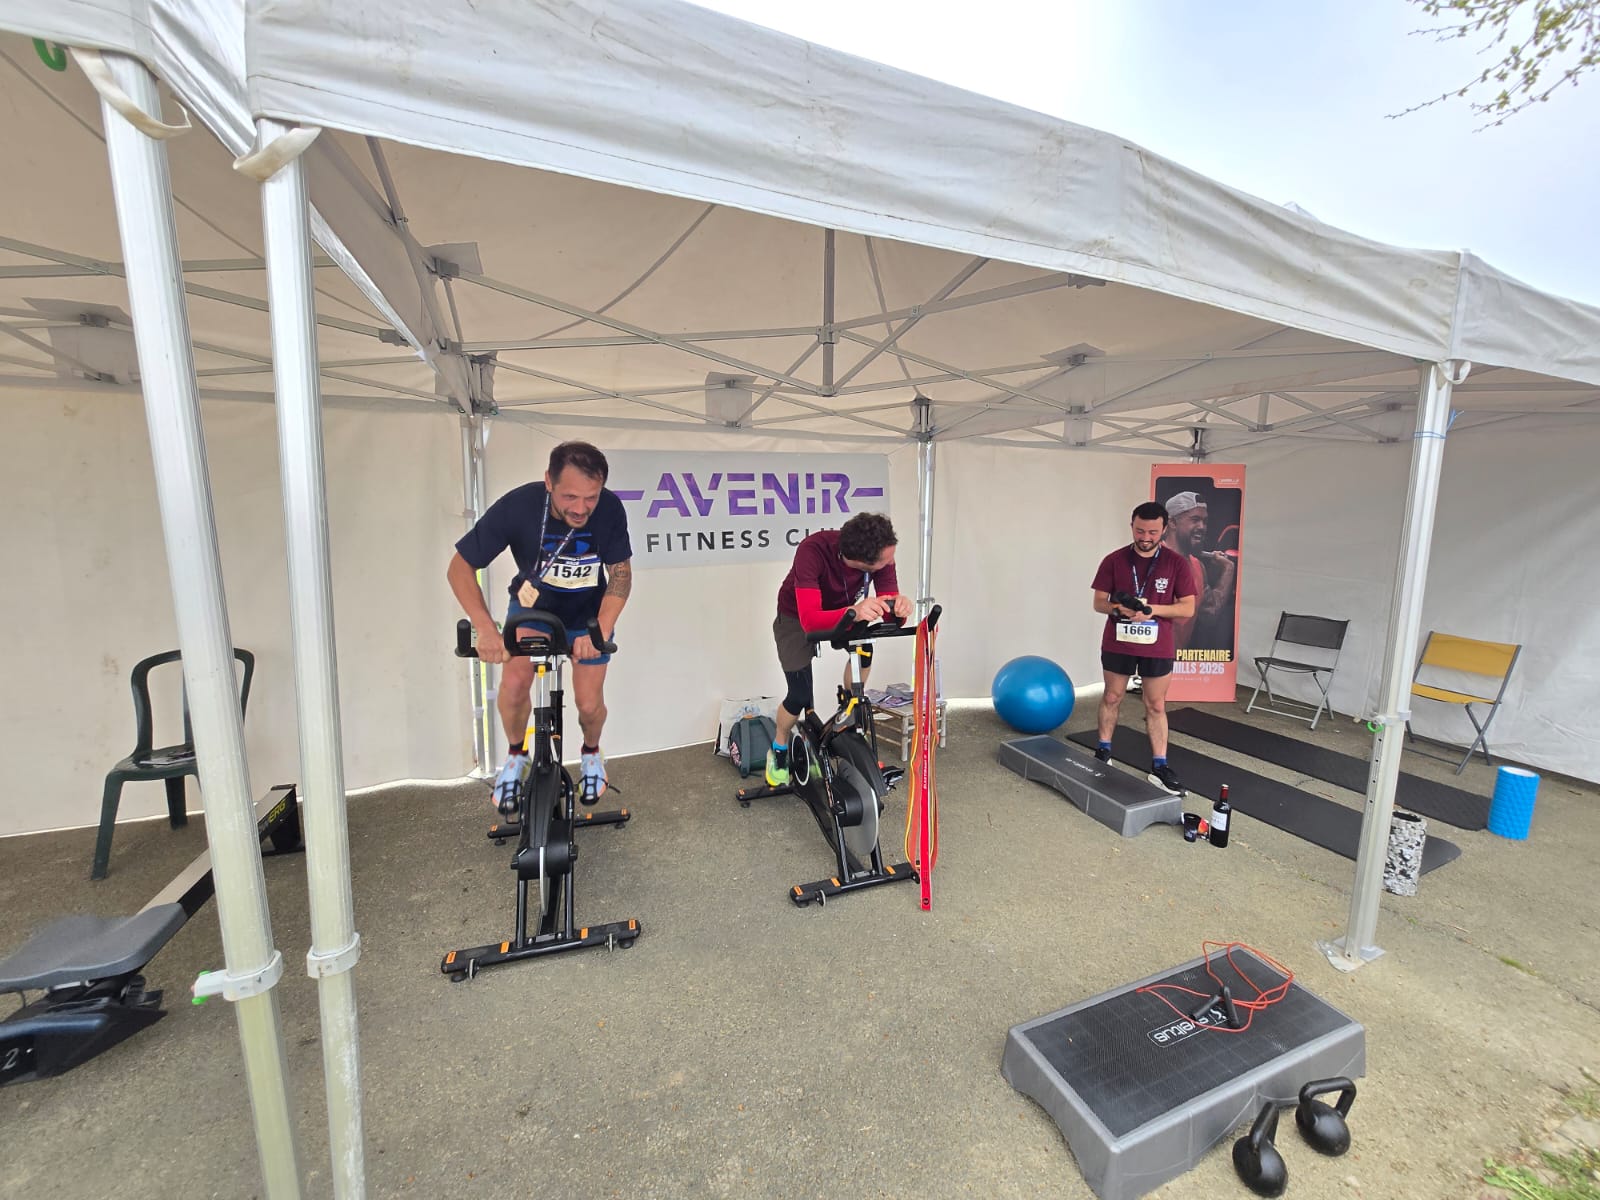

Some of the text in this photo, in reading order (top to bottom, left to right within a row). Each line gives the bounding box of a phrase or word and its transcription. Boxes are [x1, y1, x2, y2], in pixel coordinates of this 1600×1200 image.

[646, 472, 851, 518] AVENIR
[646, 529, 770, 553] FITNESS
[551, 564, 592, 578] 1542
[1123, 625, 1152, 636] 1666
[1176, 649, 1231, 661] PARTENAIRE
[1199, 662, 1225, 675] 2026
